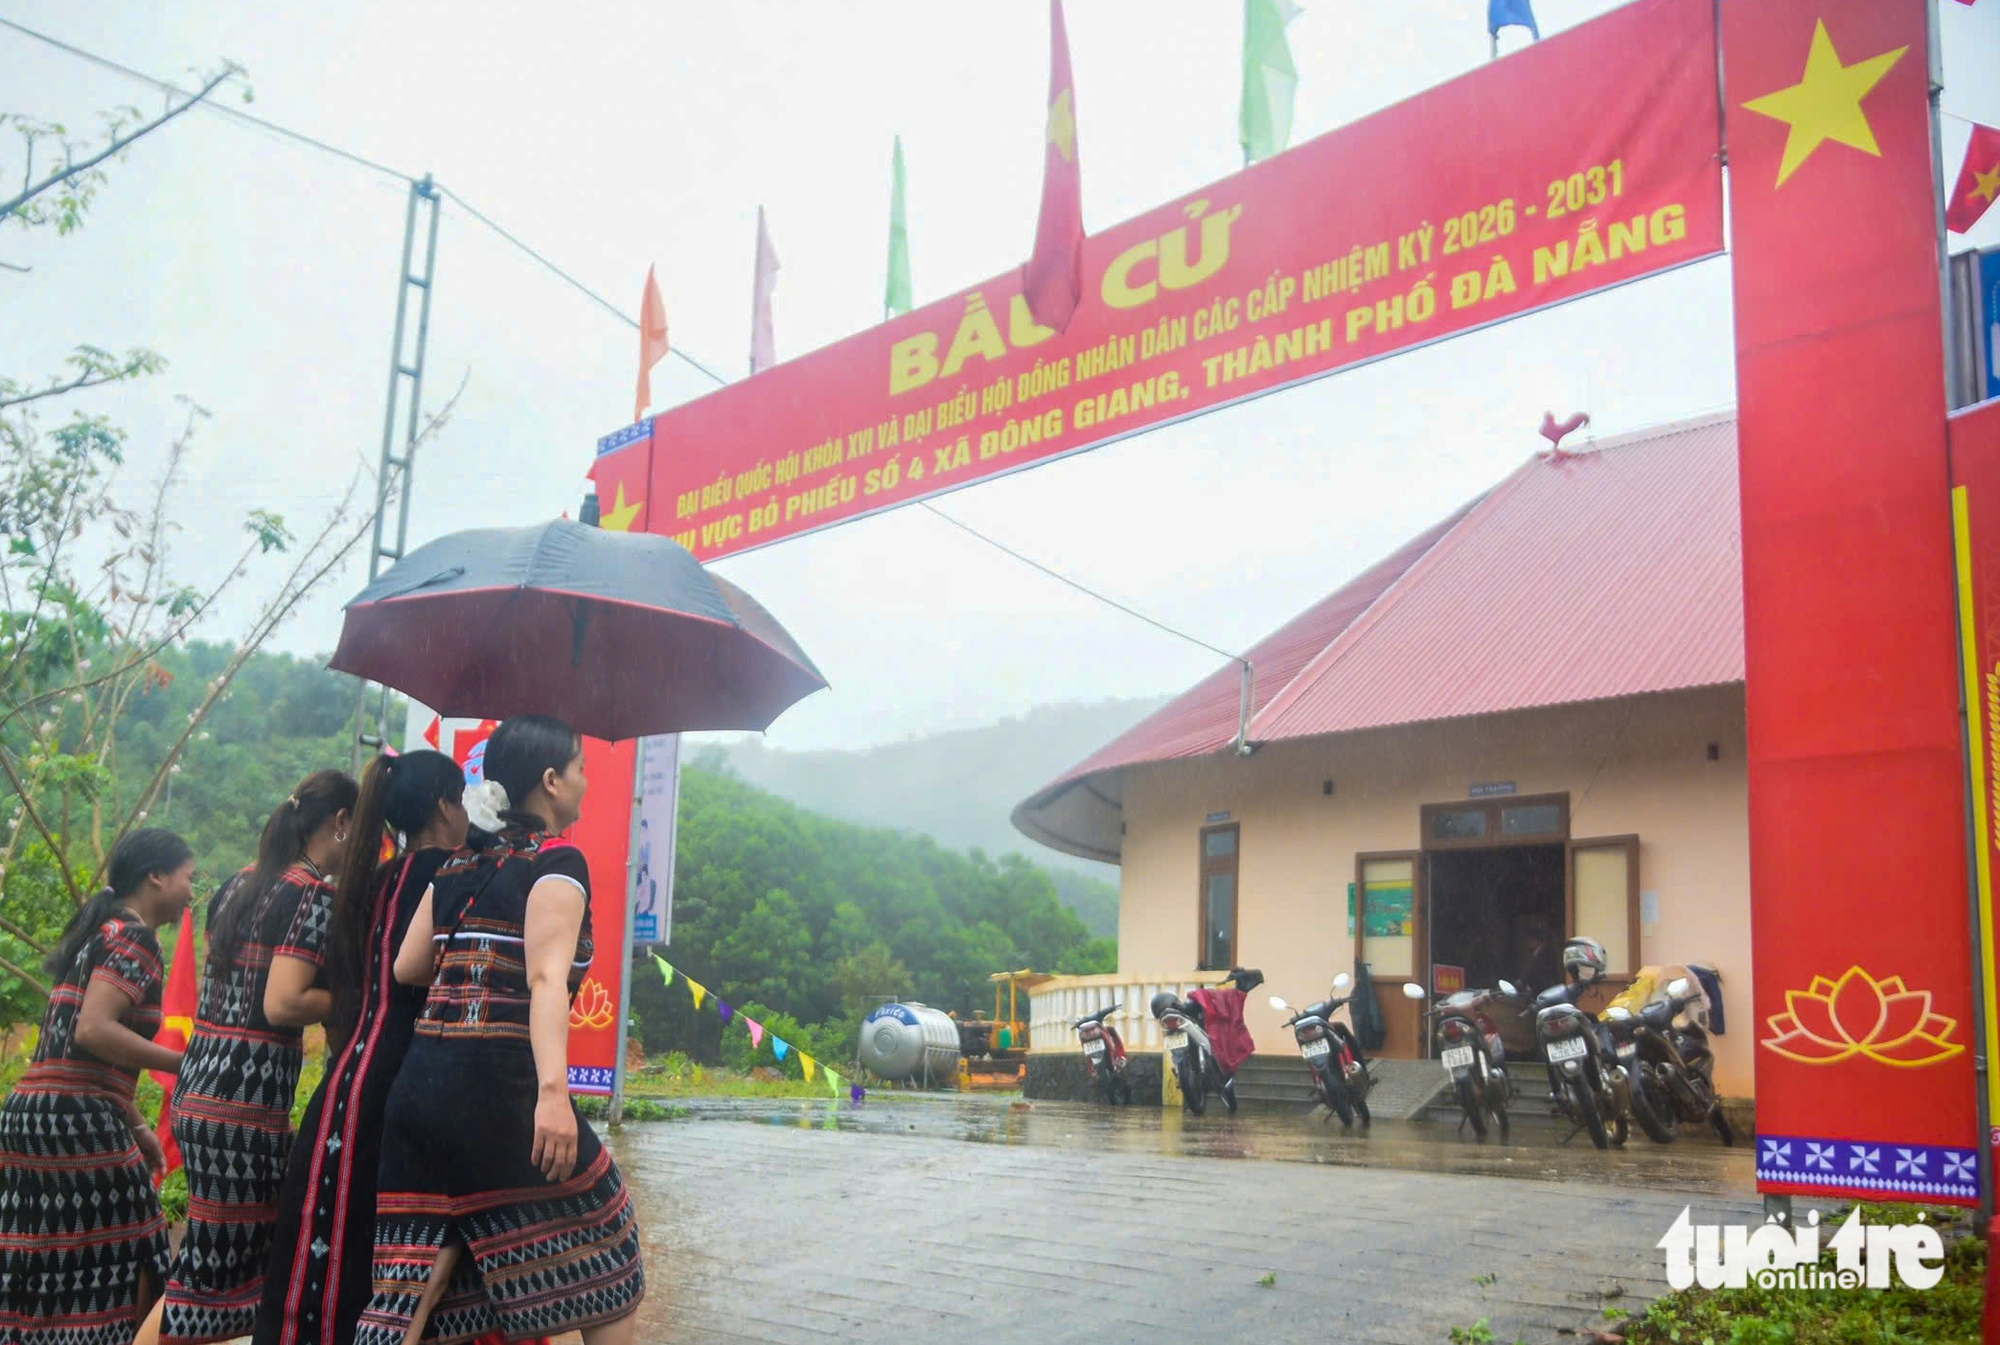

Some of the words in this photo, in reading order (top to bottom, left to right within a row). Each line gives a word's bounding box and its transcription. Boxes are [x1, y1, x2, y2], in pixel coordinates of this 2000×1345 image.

[677, 489, 699, 519] ĐẠI
[735, 458, 773, 499] QUỐC
[775, 450, 801, 487] HỘI
[847, 426, 874, 461] XVI
[878, 414, 899, 450] VÀ
[904, 406, 933, 443] ĐẠI
[937, 384, 978, 431] BIỂU
[981, 375, 1013, 417] HỘI
[1018, 357, 1071, 403] ĐỒNG
[1076, 333, 1136, 383] NHÂN
[1141, 316, 1187, 360] DÂN
[1193, 296, 1240, 342] CÁC
[1247, 268, 1296, 322] CẤP
[1303, 242, 1390, 304] NHIỆM
[1398, 220, 1434, 272] KỲ
[1443, 198, 1517, 256] 2026
[1525, 205, 1538, 216] -
[1547, 158, 1623, 220] 2031
[702, 514, 743, 549] VỰC
[748, 495, 780, 534] BỎ
[785, 473, 858, 522] PHIẾU
[863, 452, 901, 496] SỐ
[907, 455, 925, 481] 4
[933, 435, 972, 475] XÃ
[979, 407, 1064, 461] ĐÔNG
[1073, 370, 1190, 430] GIANG,
[1202, 318, 1333, 389] THÀNH
[1346, 271, 1437, 344] PHỐ
[1449, 254, 1518, 310] ĐÀ
[1532, 203, 1687, 286] NẴNG
[1101, 198, 1244, 310] CỬ
